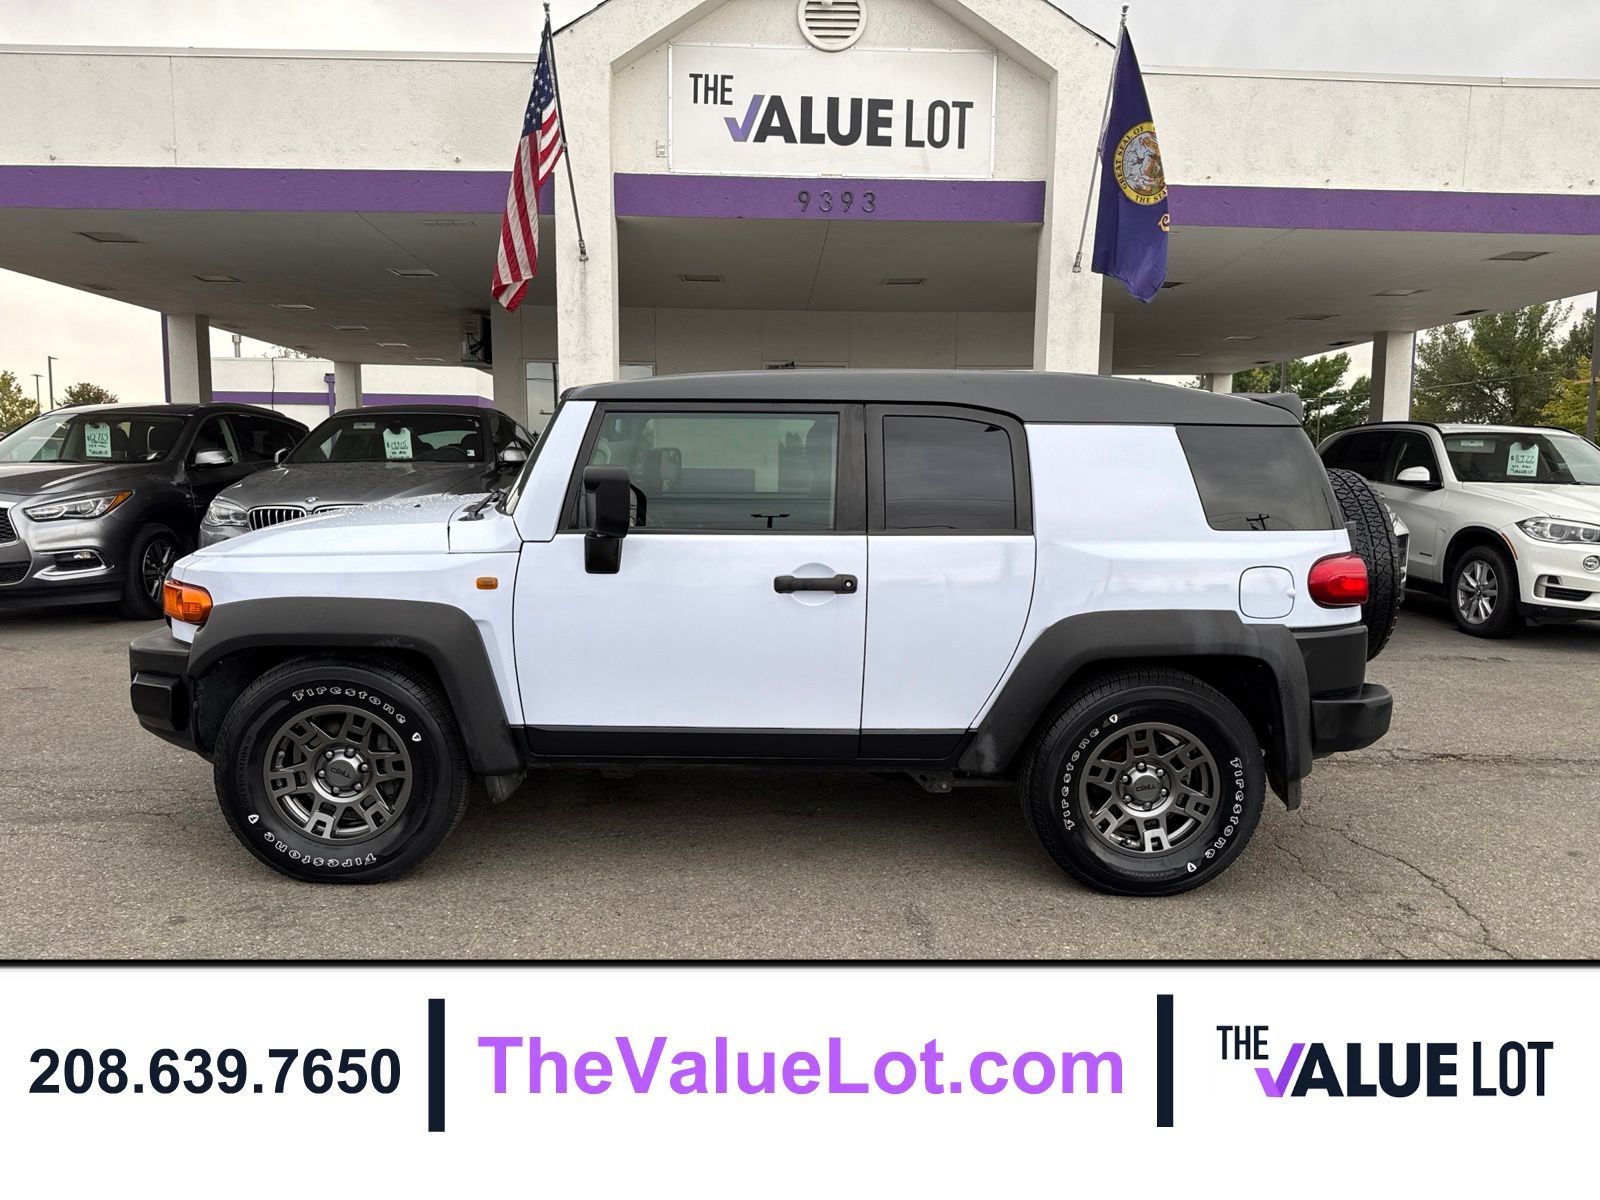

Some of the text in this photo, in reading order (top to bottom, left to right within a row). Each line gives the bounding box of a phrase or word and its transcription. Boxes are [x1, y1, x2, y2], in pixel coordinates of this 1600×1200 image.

[689, 73, 734, 106] THE
[905, 99, 974, 149] LOT
[1116, 125, 1145, 190] GREAT SEAL OF
[797, 190, 876, 213] 9393
[1135, 195, 1150, 204] THE
[292, 686, 406, 724] Firestone
[1061, 728, 1100, 831] Firestone
[1204, 757, 1245, 859] Firestone
[264, 831, 377, 866] Firestone
